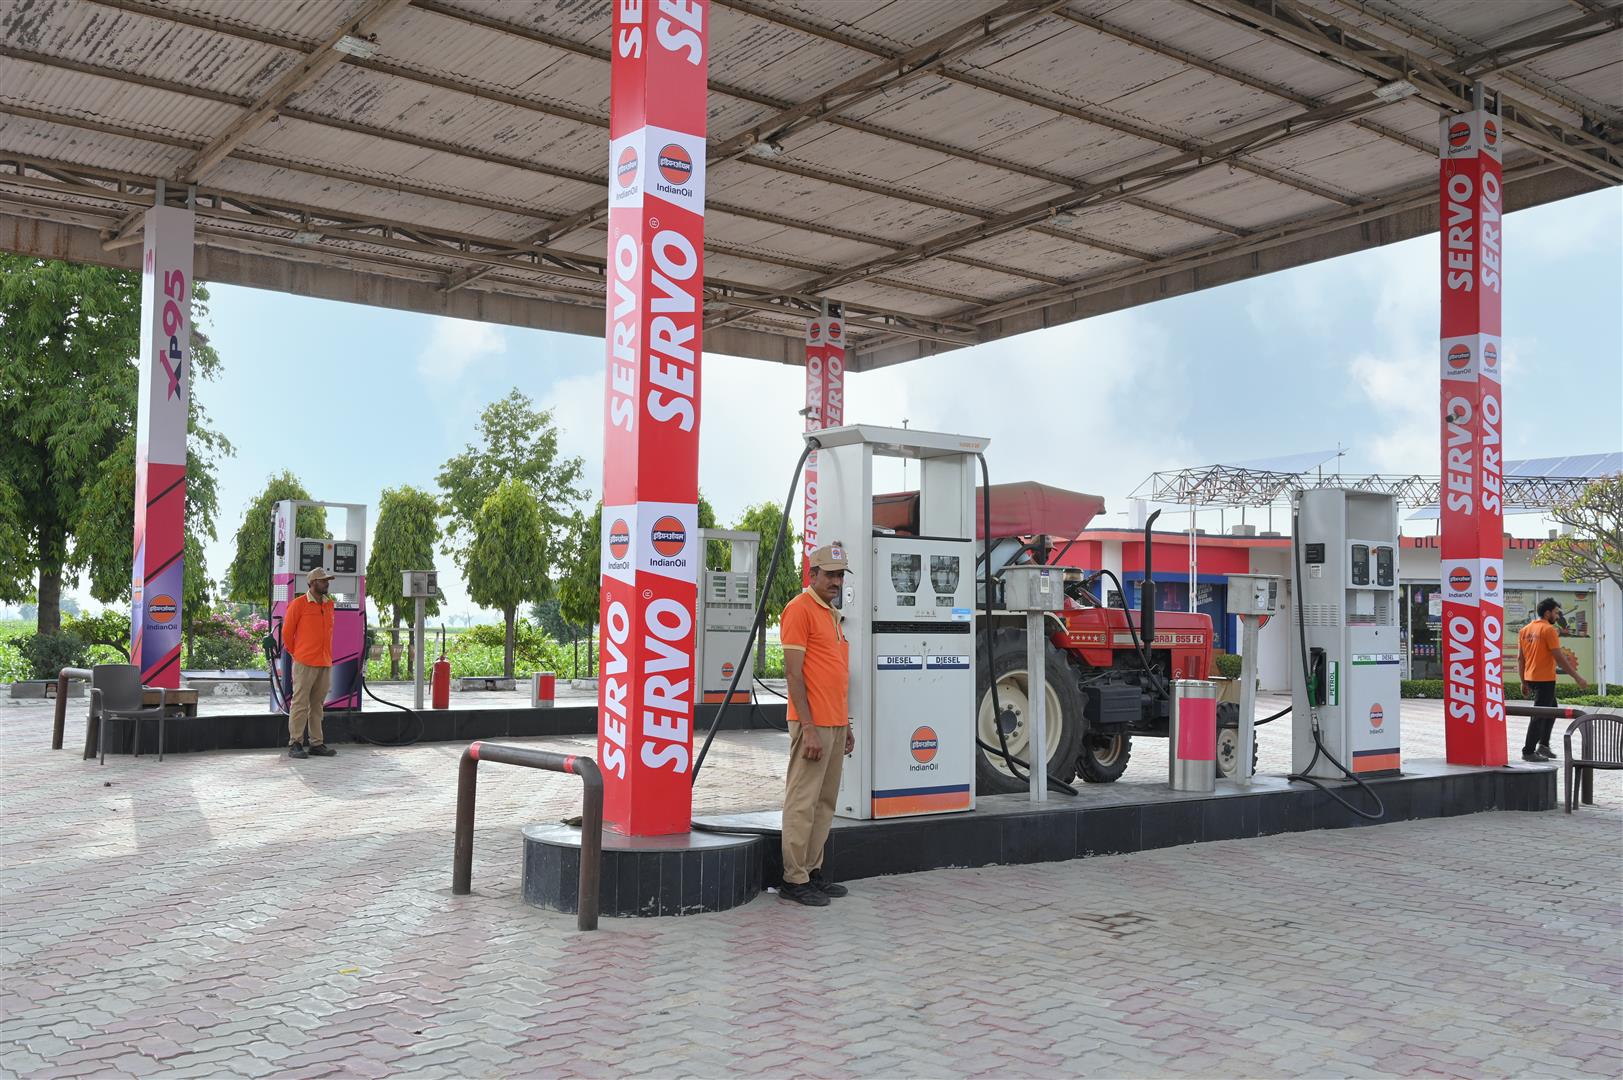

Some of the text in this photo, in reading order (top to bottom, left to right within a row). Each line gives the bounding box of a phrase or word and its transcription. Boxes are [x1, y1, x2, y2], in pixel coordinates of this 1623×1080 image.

[657, 183, 693, 198] IndianOil
[1447, 173, 1474, 293] SERVO
[1481, 170, 1500, 295] SERVO
[159, 269, 185, 403] XP95
[610, 233, 638, 433] SERVO
[647, 229, 698, 433] SERVO
[1447, 396, 1474, 516] SERVO
[1482, 394, 1500, 516] SERVO
[608, 561, 630, 570] IndianOil
[650, 558, 687, 568] IndianOil
[1414, 537, 1439, 549] OIL
[602, 601, 630, 780] SERVO
[640, 598, 692, 774] SERVO
[886, 656, 913, 664] DIESEL
[935, 656, 961, 664] DIESEL
[1192, 635, 1202, 643] FE
[1449, 616, 1477, 724] SERVO
[1483, 615, 1504, 722] SERVO
[909, 763, 939, 772] IndianOil
